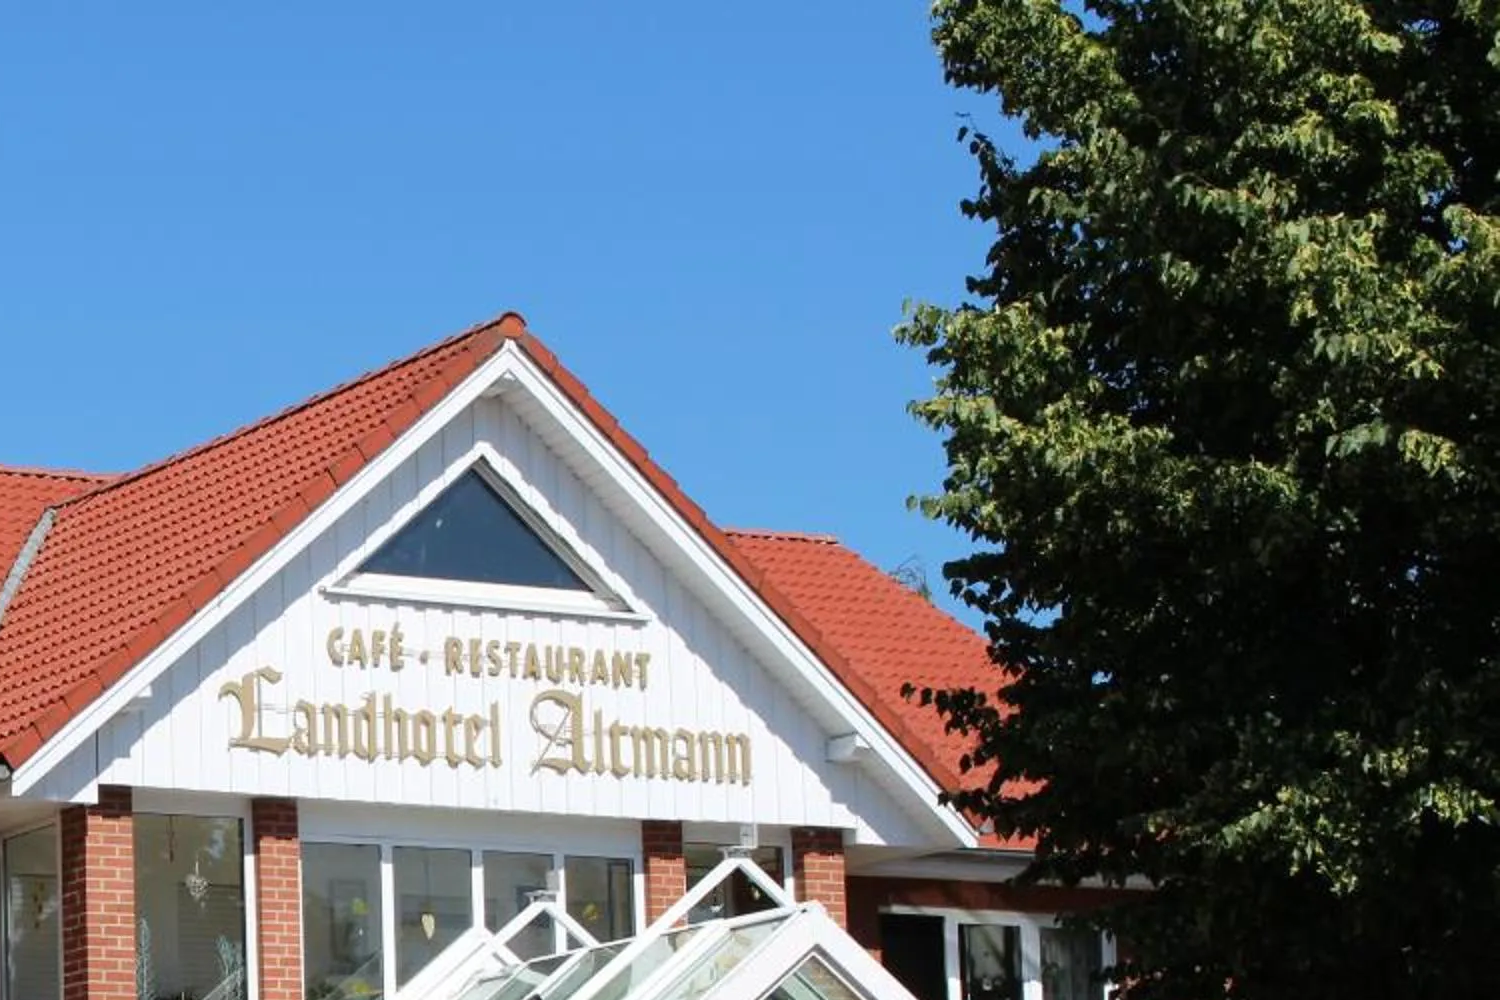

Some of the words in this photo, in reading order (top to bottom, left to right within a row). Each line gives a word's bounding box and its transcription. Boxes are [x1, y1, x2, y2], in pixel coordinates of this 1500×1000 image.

[327, 624, 405, 672] CAFÉ
[444, 636, 651, 690] RESTAURANT
[218, 665, 503, 770] Landhotel
[530, 689, 754, 788] Altmann
